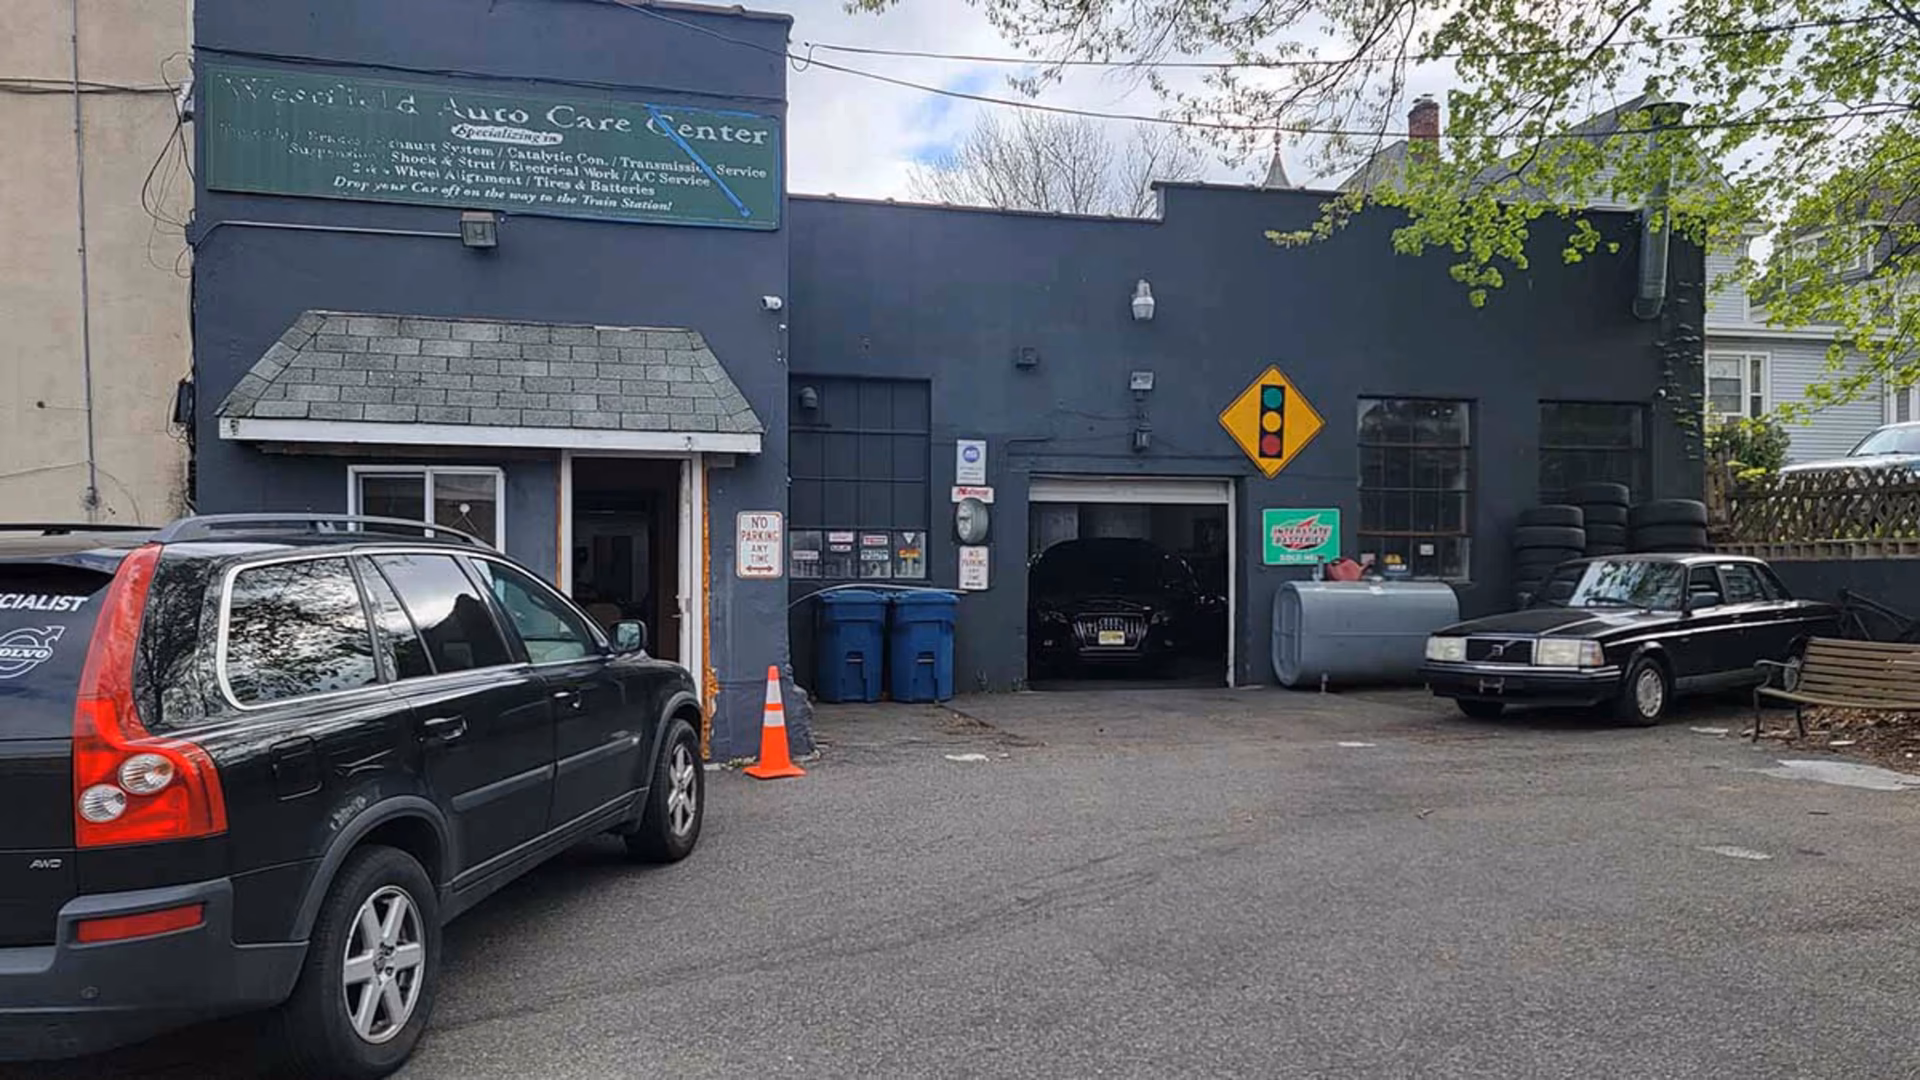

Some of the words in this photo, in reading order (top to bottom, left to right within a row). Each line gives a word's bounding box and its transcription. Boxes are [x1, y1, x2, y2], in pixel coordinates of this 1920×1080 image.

[217, 74, 419, 115] Westfild
[438, 97, 529, 124] Auto
[546, 105, 632, 133] Care
[646, 114, 768, 145] Center
[455, 125, 541, 144] Specializing
[442, 141, 494, 157] System
[508, 147, 573, 163] Catalytic
[577, 154, 609, 166] Con.
[620, 157, 707, 174] Transmissi
[716, 163, 767, 179] Service
[391, 151, 438, 165] Shock
[458, 156, 496, 169] Strut
[509, 160, 579, 175] Electrical
[584, 166, 619, 180] Work
[631, 171, 656, 183] A/C
[659, 173, 711, 188] Service
[395, 165, 440, 179] Wheel
[445, 169, 522, 185] Alignment
[534, 175, 571, 190] Tires
[575, 181, 586, 191] &
[590, 182, 655, 196] Batteries
[333, 176, 370, 192] Drop
[373, 181, 408, 193] your
[411, 182, 438, 194] Car
[441, 185, 462, 198] off
[464, 186, 481, 196] on
[484, 187, 505, 199] the
[509, 192, 536, 205] way
[540, 193, 553, 202] to
[557, 193, 578, 204] the
[582, 194, 618, 206] Train
[621, 198, 673, 211] Station!
[751, 516, 769, 529] NO
[741, 530, 779, 542] PARKING
[1273, 527, 1330, 536] INTERSTATE
[1275, 536, 1326, 544] BATTERIES
[751, 544, 769, 553] ANY
[751, 553, 769, 564] TIME
[0, 647, 49, 659] OLVO
[29, 858, 62, 869] AWD
